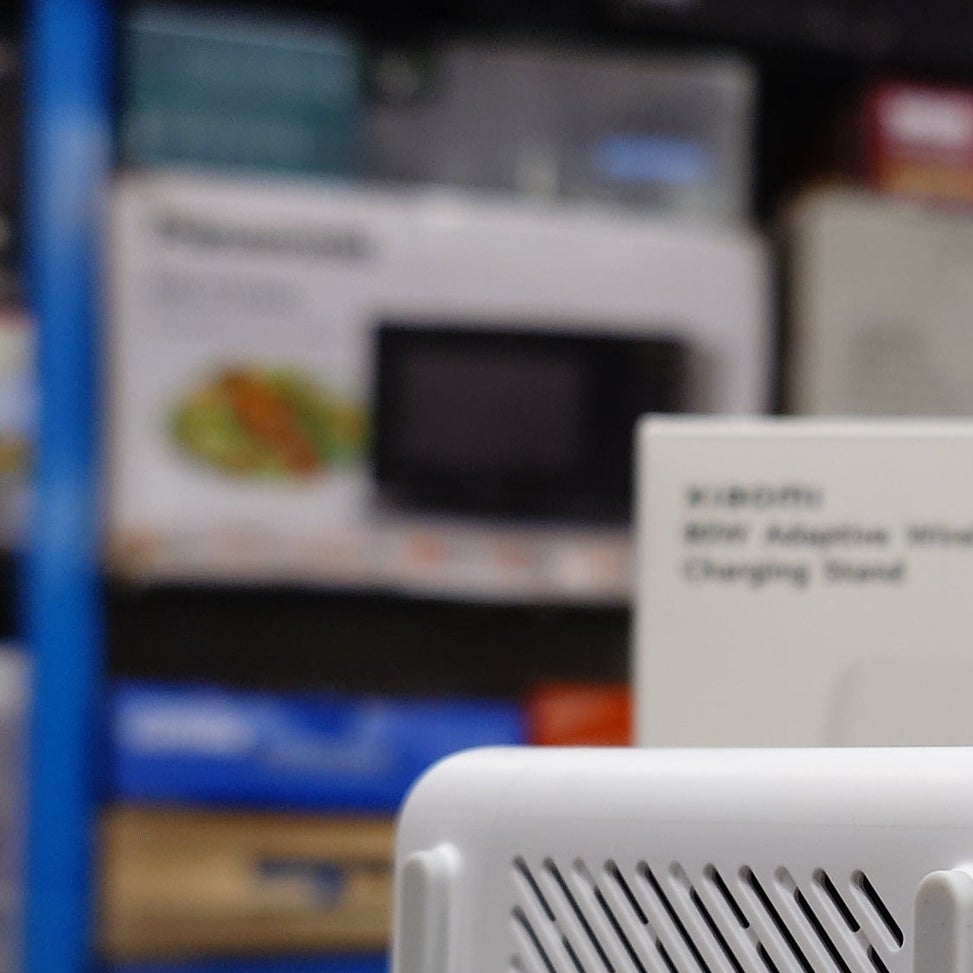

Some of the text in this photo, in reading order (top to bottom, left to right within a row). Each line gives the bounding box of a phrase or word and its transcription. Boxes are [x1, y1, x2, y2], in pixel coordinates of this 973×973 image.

[767, 525, 888, 552] Adaptive
[685, 556, 906, 589] Charging Stand
